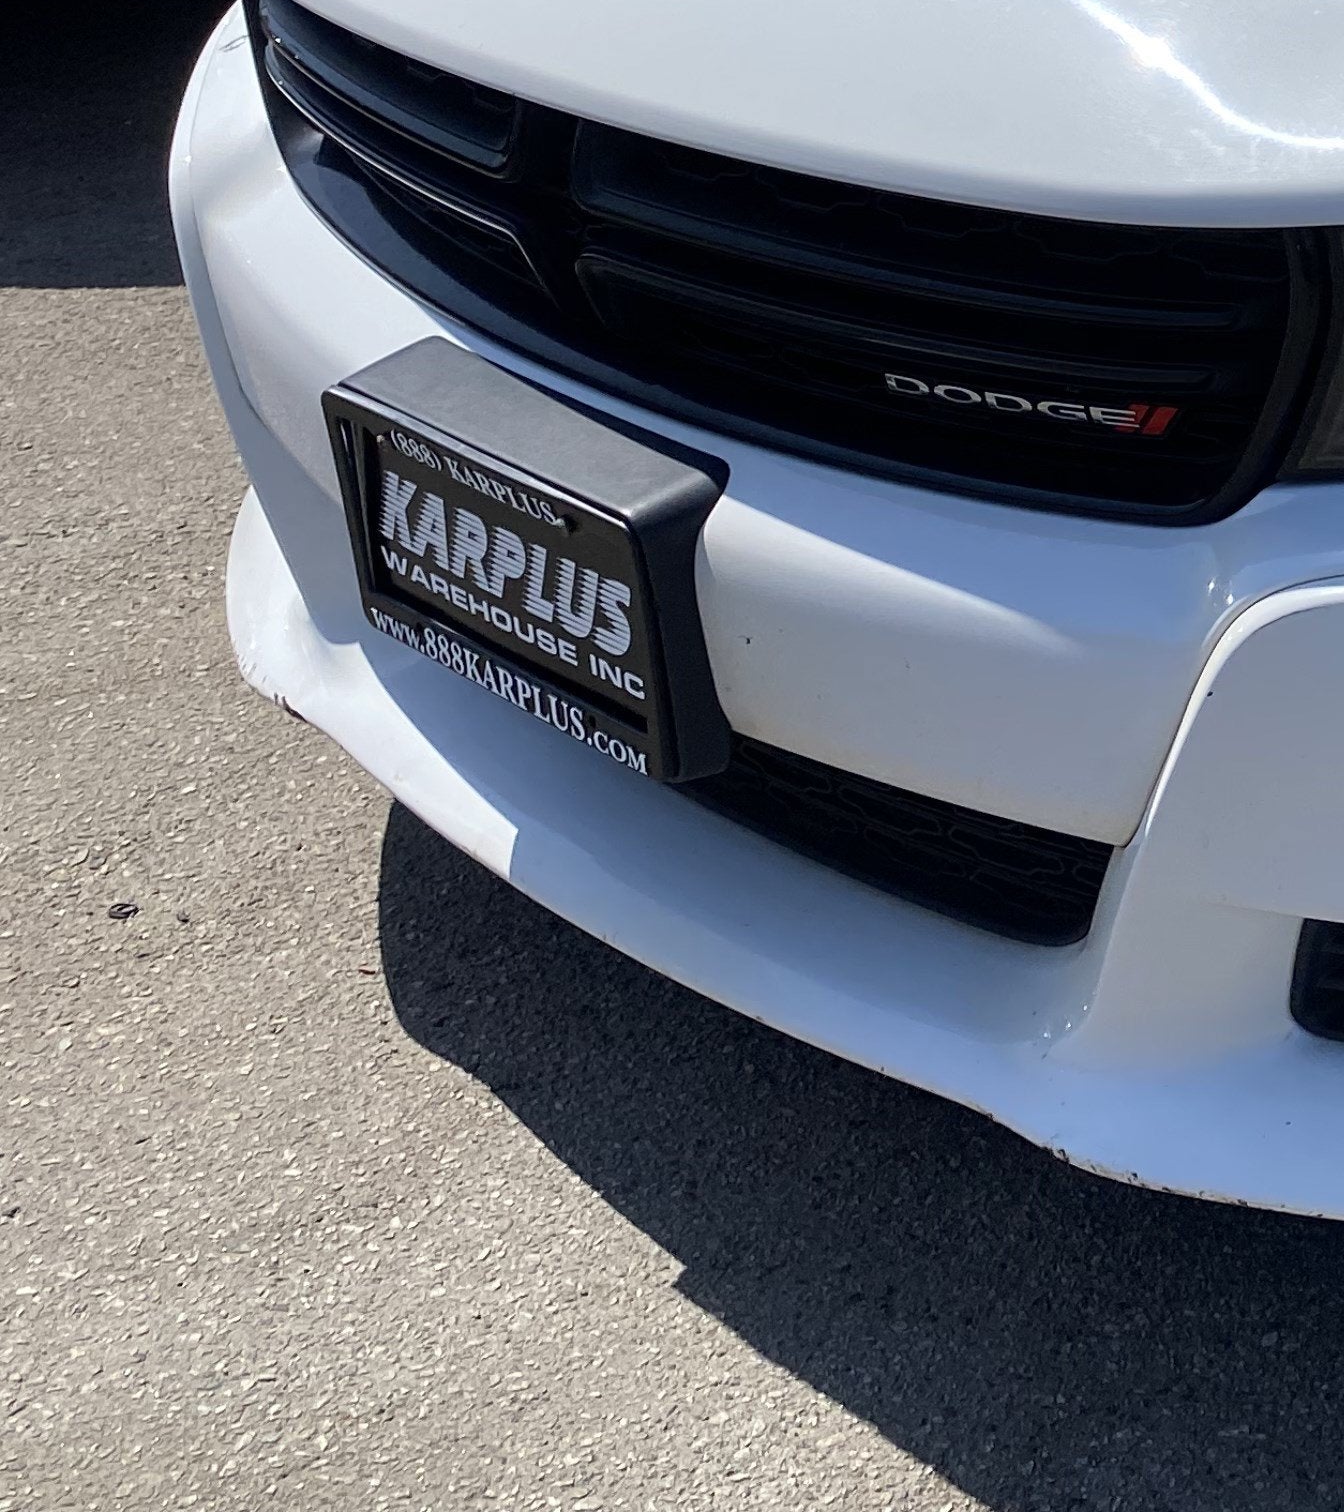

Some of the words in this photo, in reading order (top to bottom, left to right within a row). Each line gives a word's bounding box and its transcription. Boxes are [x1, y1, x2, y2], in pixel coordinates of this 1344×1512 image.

[884, 372, 1140, 428] DODGE
[390, 429, 442, 472] (888)
[443, 456, 560, 527] KARPLUS
[379, 470, 633, 657] KARPLUS
[380, 545, 579, 667] WAREHOUSE
[589, 653, 646, 700] INC
